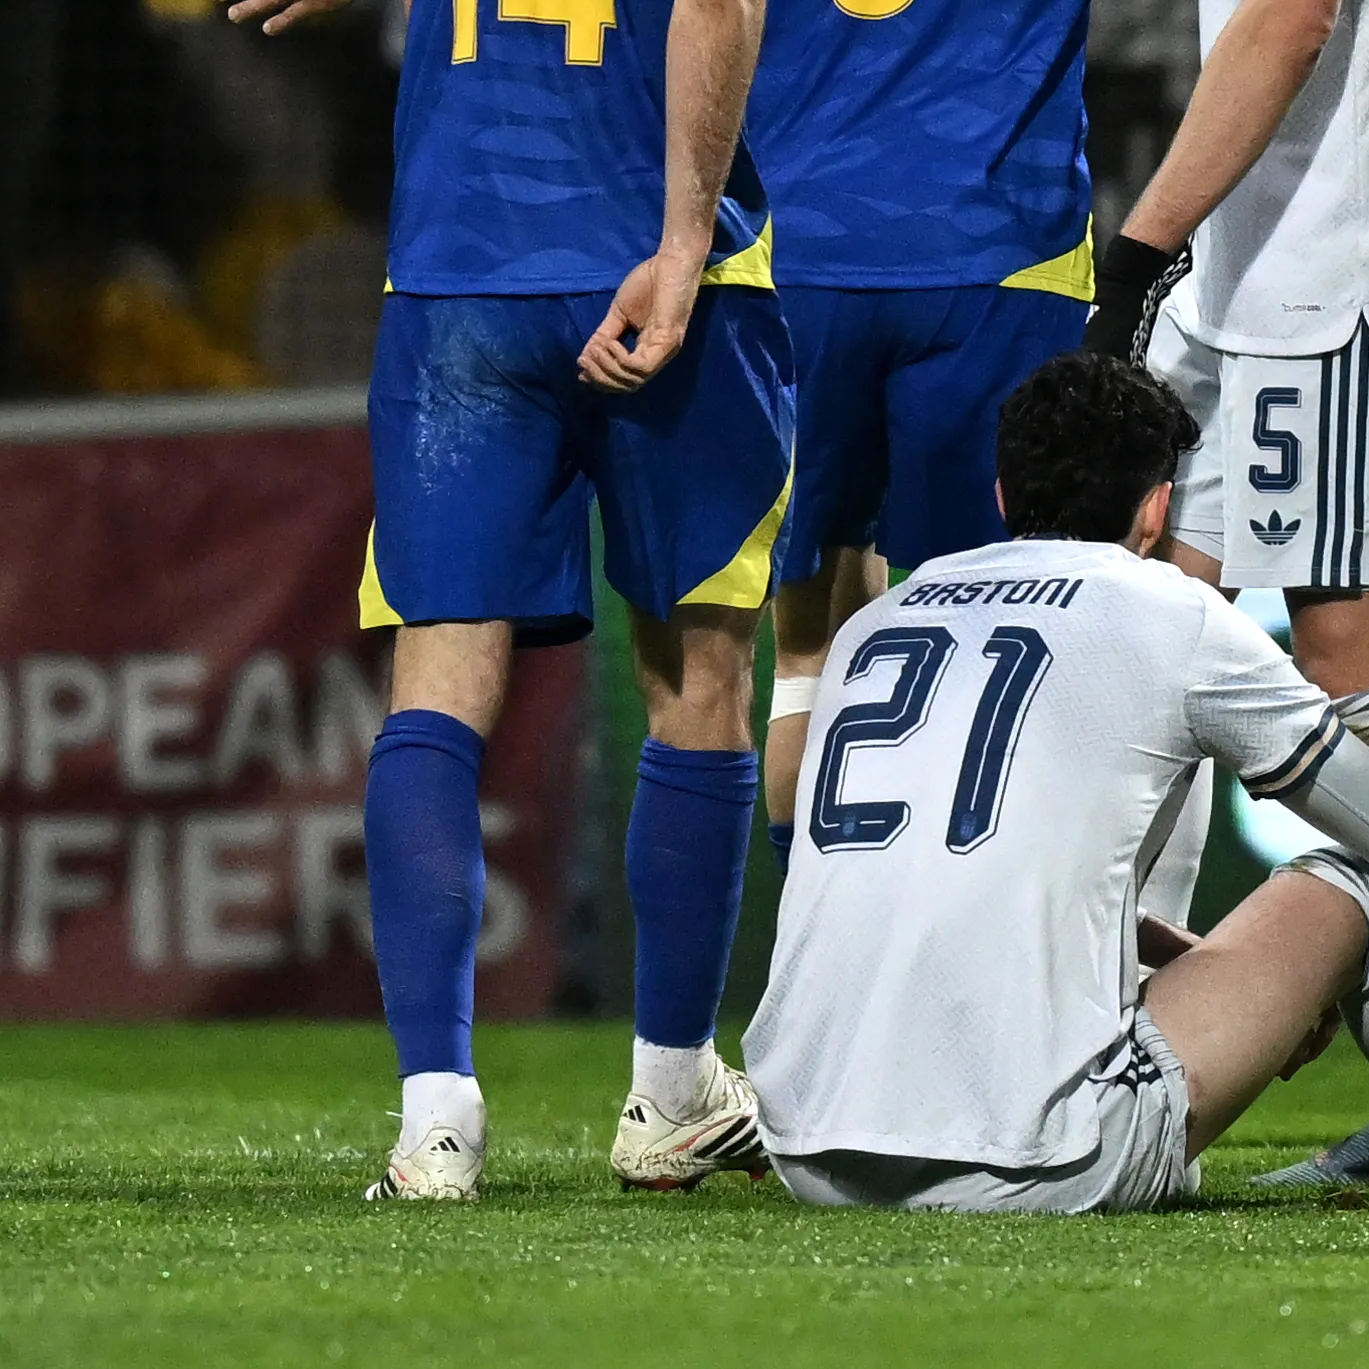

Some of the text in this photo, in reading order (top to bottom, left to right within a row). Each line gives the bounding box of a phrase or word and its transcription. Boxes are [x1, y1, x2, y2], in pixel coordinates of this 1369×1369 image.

[1248, 386, 1302, 494] 5
[899, 577, 1085, 609] BASTONI
[809, 625, 1055, 855] 21
